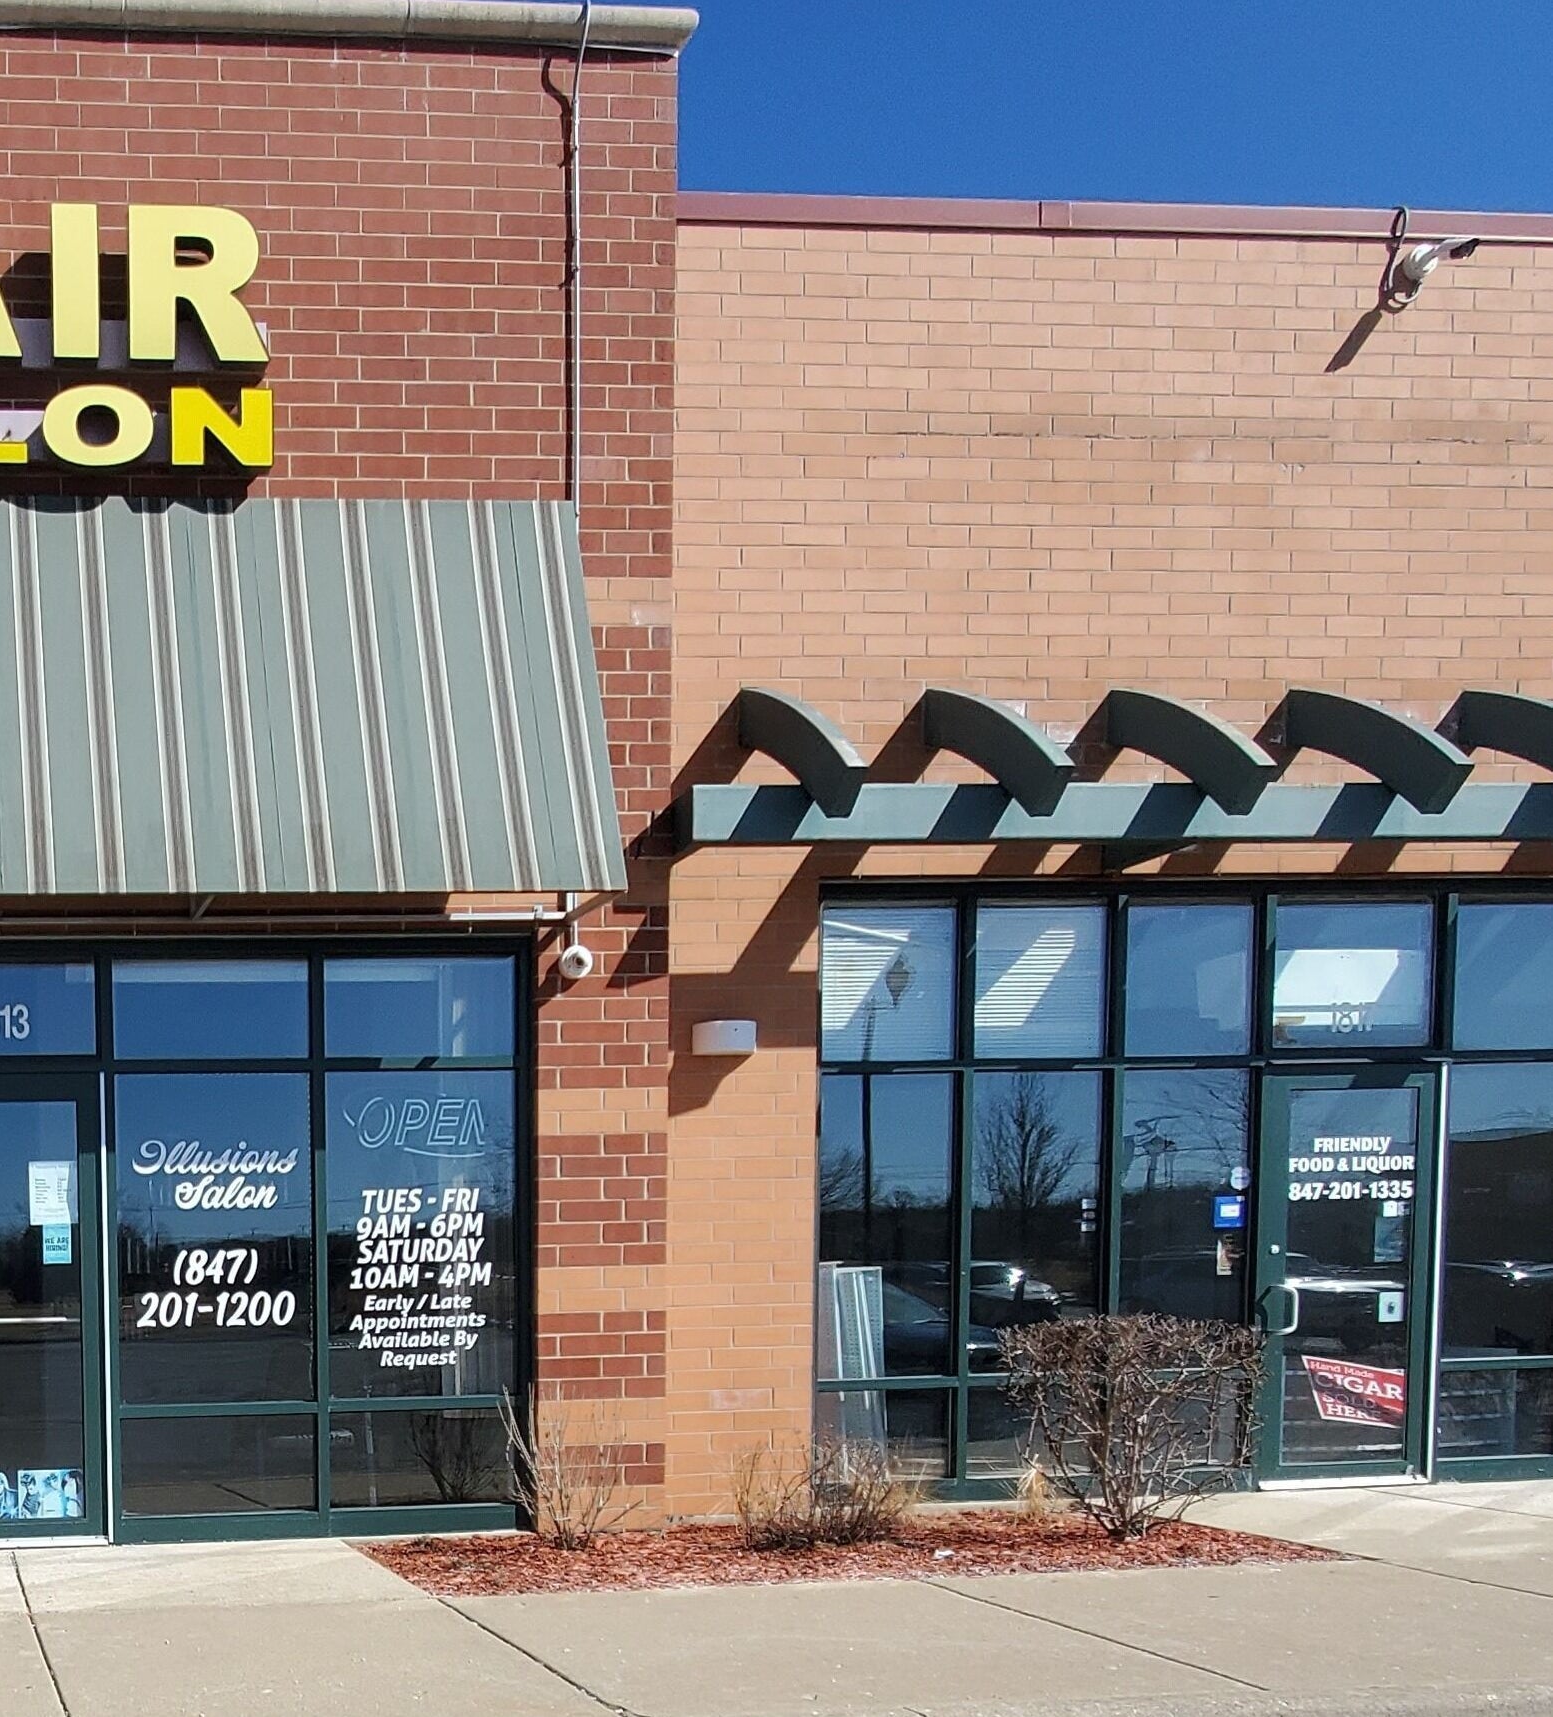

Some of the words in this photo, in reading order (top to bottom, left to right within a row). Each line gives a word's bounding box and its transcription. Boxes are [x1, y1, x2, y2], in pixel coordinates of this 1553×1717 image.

[357, 1096, 486, 1148] OPEN
[1313, 1136, 1391, 1154] FRIENDLY
[131, 1139, 299, 1175] Illusions
[1288, 1157, 1334, 1173] FOOD
[1336, 1158, 1350, 1172] &
[1351, 1155, 1415, 1175] LIQUOR
[174, 1175, 278, 1210] Salon
[361, 1188, 423, 1214] TUES
[441, 1188, 480, 1213] FRI
[1288, 1180, 1414, 1201] 847-201-1335
[356, 1214, 411, 1241] 9AM
[430, 1213, 484, 1238] 6PM
[357, 1237, 485, 1265] SATURDAY
[173, 1248, 258, 1286] (847)
[349, 1264, 419, 1290] 10AM
[437, 1262, 492, 1288] 4PM
[136, 1290, 296, 1328] 201-1200
[364, 1294, 414, 1315] Early
[430, 1293, 472, 1310] Late
[349, 1312, 487, 1334] Appointments
[358, 1331, 451, 1350] Available
[454, 1330, 478, 1350] By
[380, 1351, 457, 1371] Request
[1310, 1361, 1341, 1373] Hand
[1344, 1366, 1375, 1379] Made
[1322, 1392, 1376, 1409] SOLD
[1326, 1403, 1382, 1420] HERE
